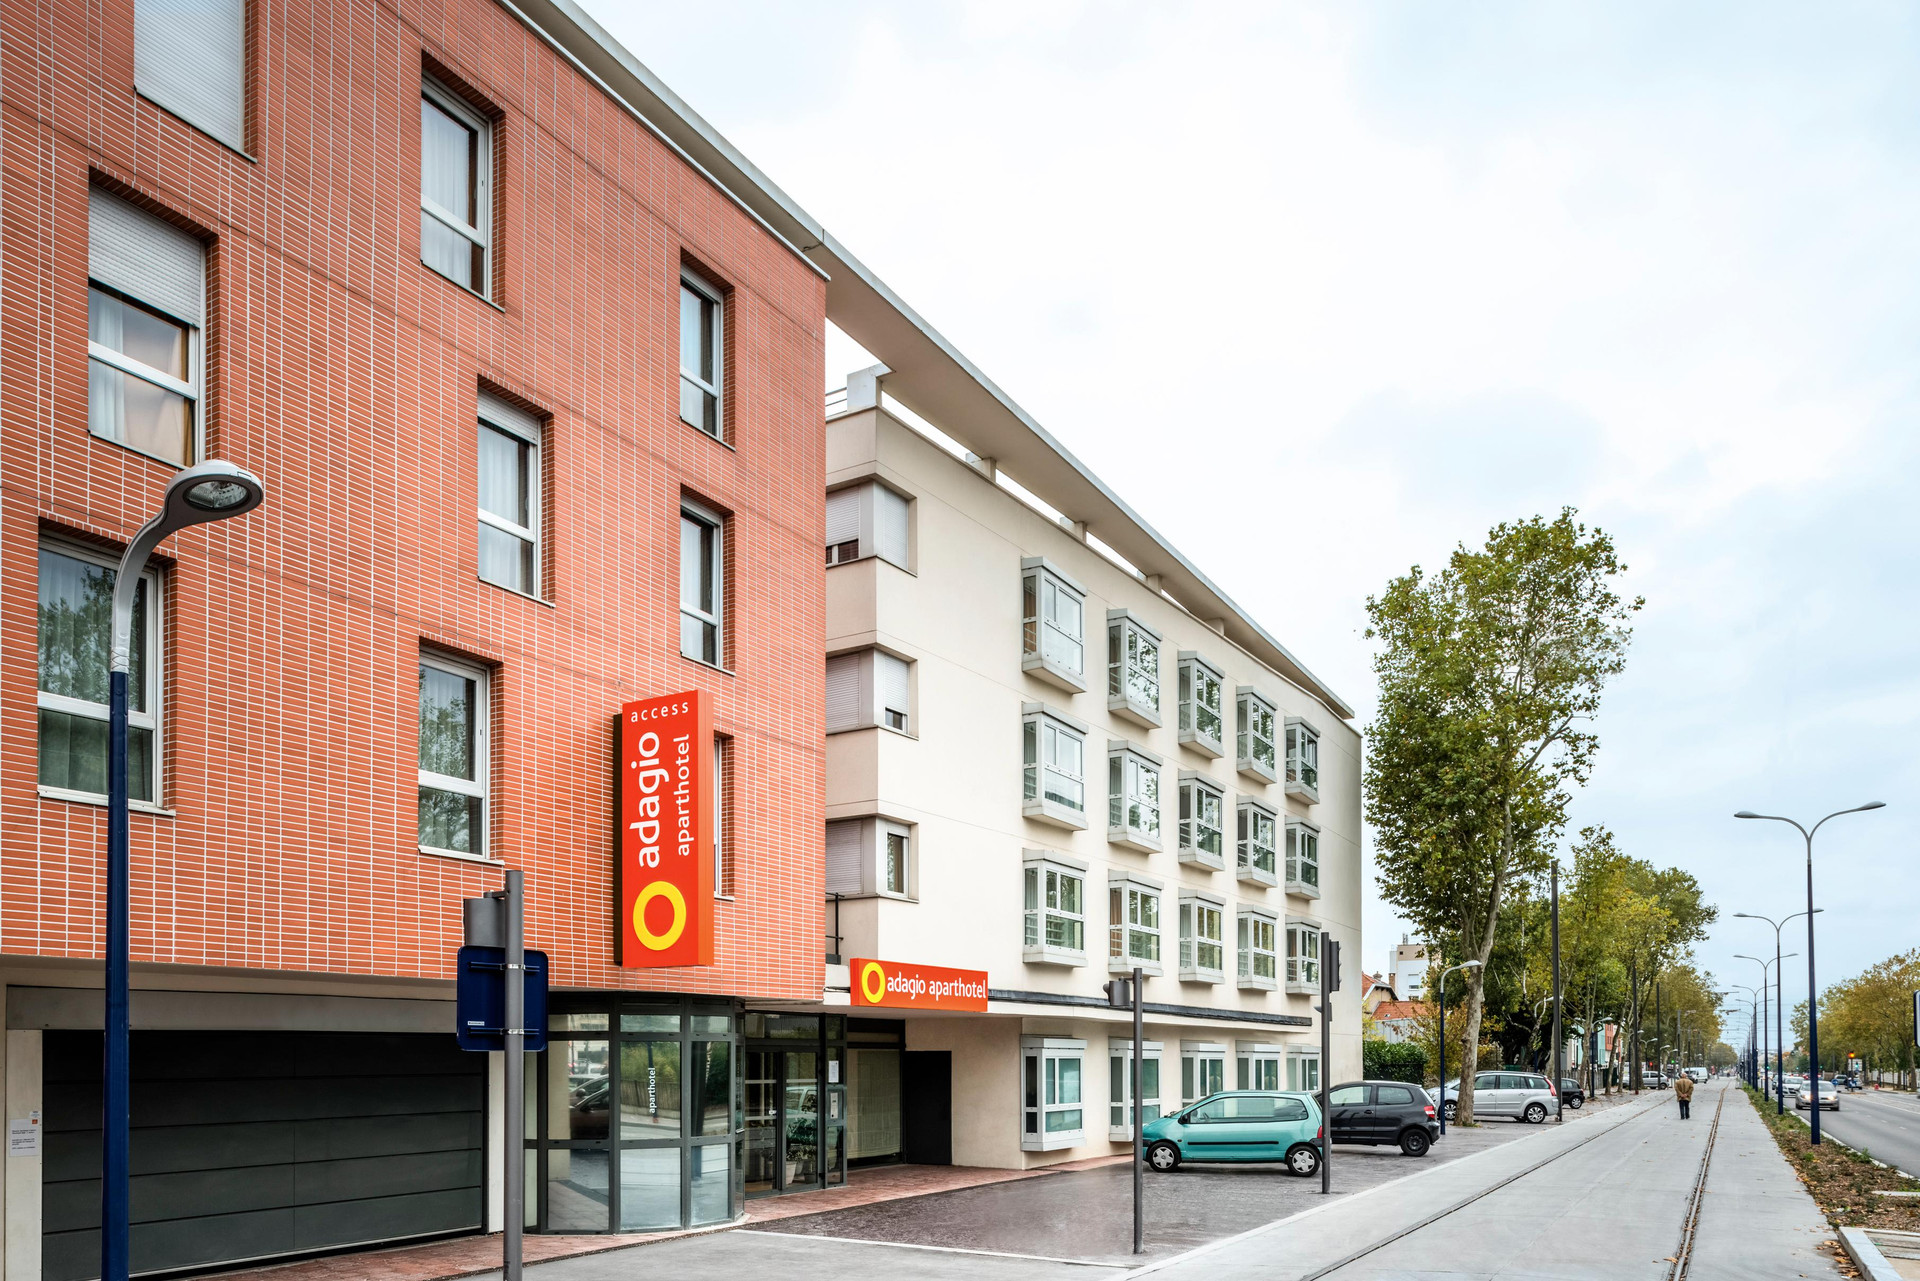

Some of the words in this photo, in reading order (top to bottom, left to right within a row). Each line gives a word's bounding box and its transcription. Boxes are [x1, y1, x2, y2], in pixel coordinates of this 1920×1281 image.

[631, 702, 689, 722] access
[629, 731, 670, 869] adagio
[673, 733, 694, 856] aparthotel
[887, 971, 926, 1000] adagio
[929, 977, 987, 1001] aparthotel
[647, 1067, 658, 1114] aparthotel
